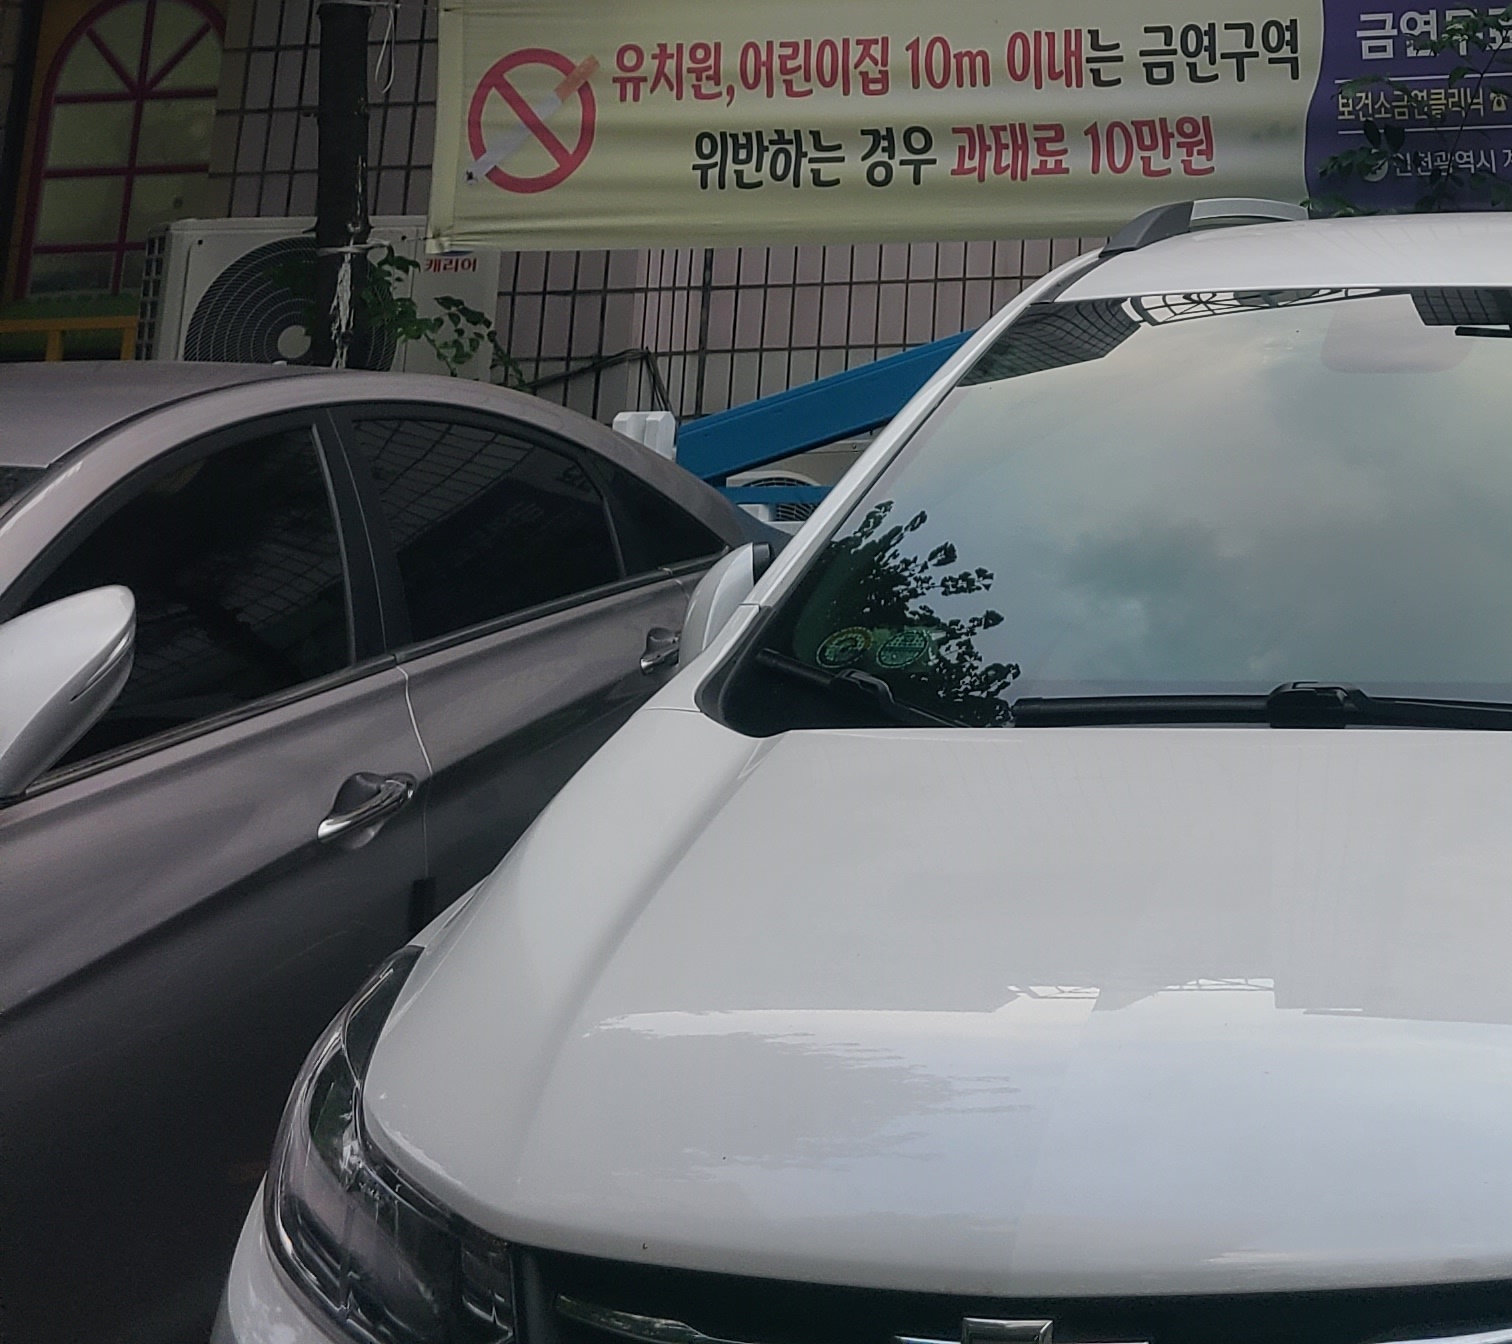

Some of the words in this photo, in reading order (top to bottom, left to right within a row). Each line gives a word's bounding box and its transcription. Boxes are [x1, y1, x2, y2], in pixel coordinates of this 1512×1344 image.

[611, 35, 890, 108] 유치원,어린이집
[905, 36, 991, 90] 10m
[1006, 28, 1125, 90] 이내는
[1138, 18, 1300, 86] 금연구역
[692, 128, 846, 190] 위반하는
[860, 125, 938, 188] 경우
[950, 122, 1070, 183] 과태료
[1083, 115, 1216, 178] 10만원
